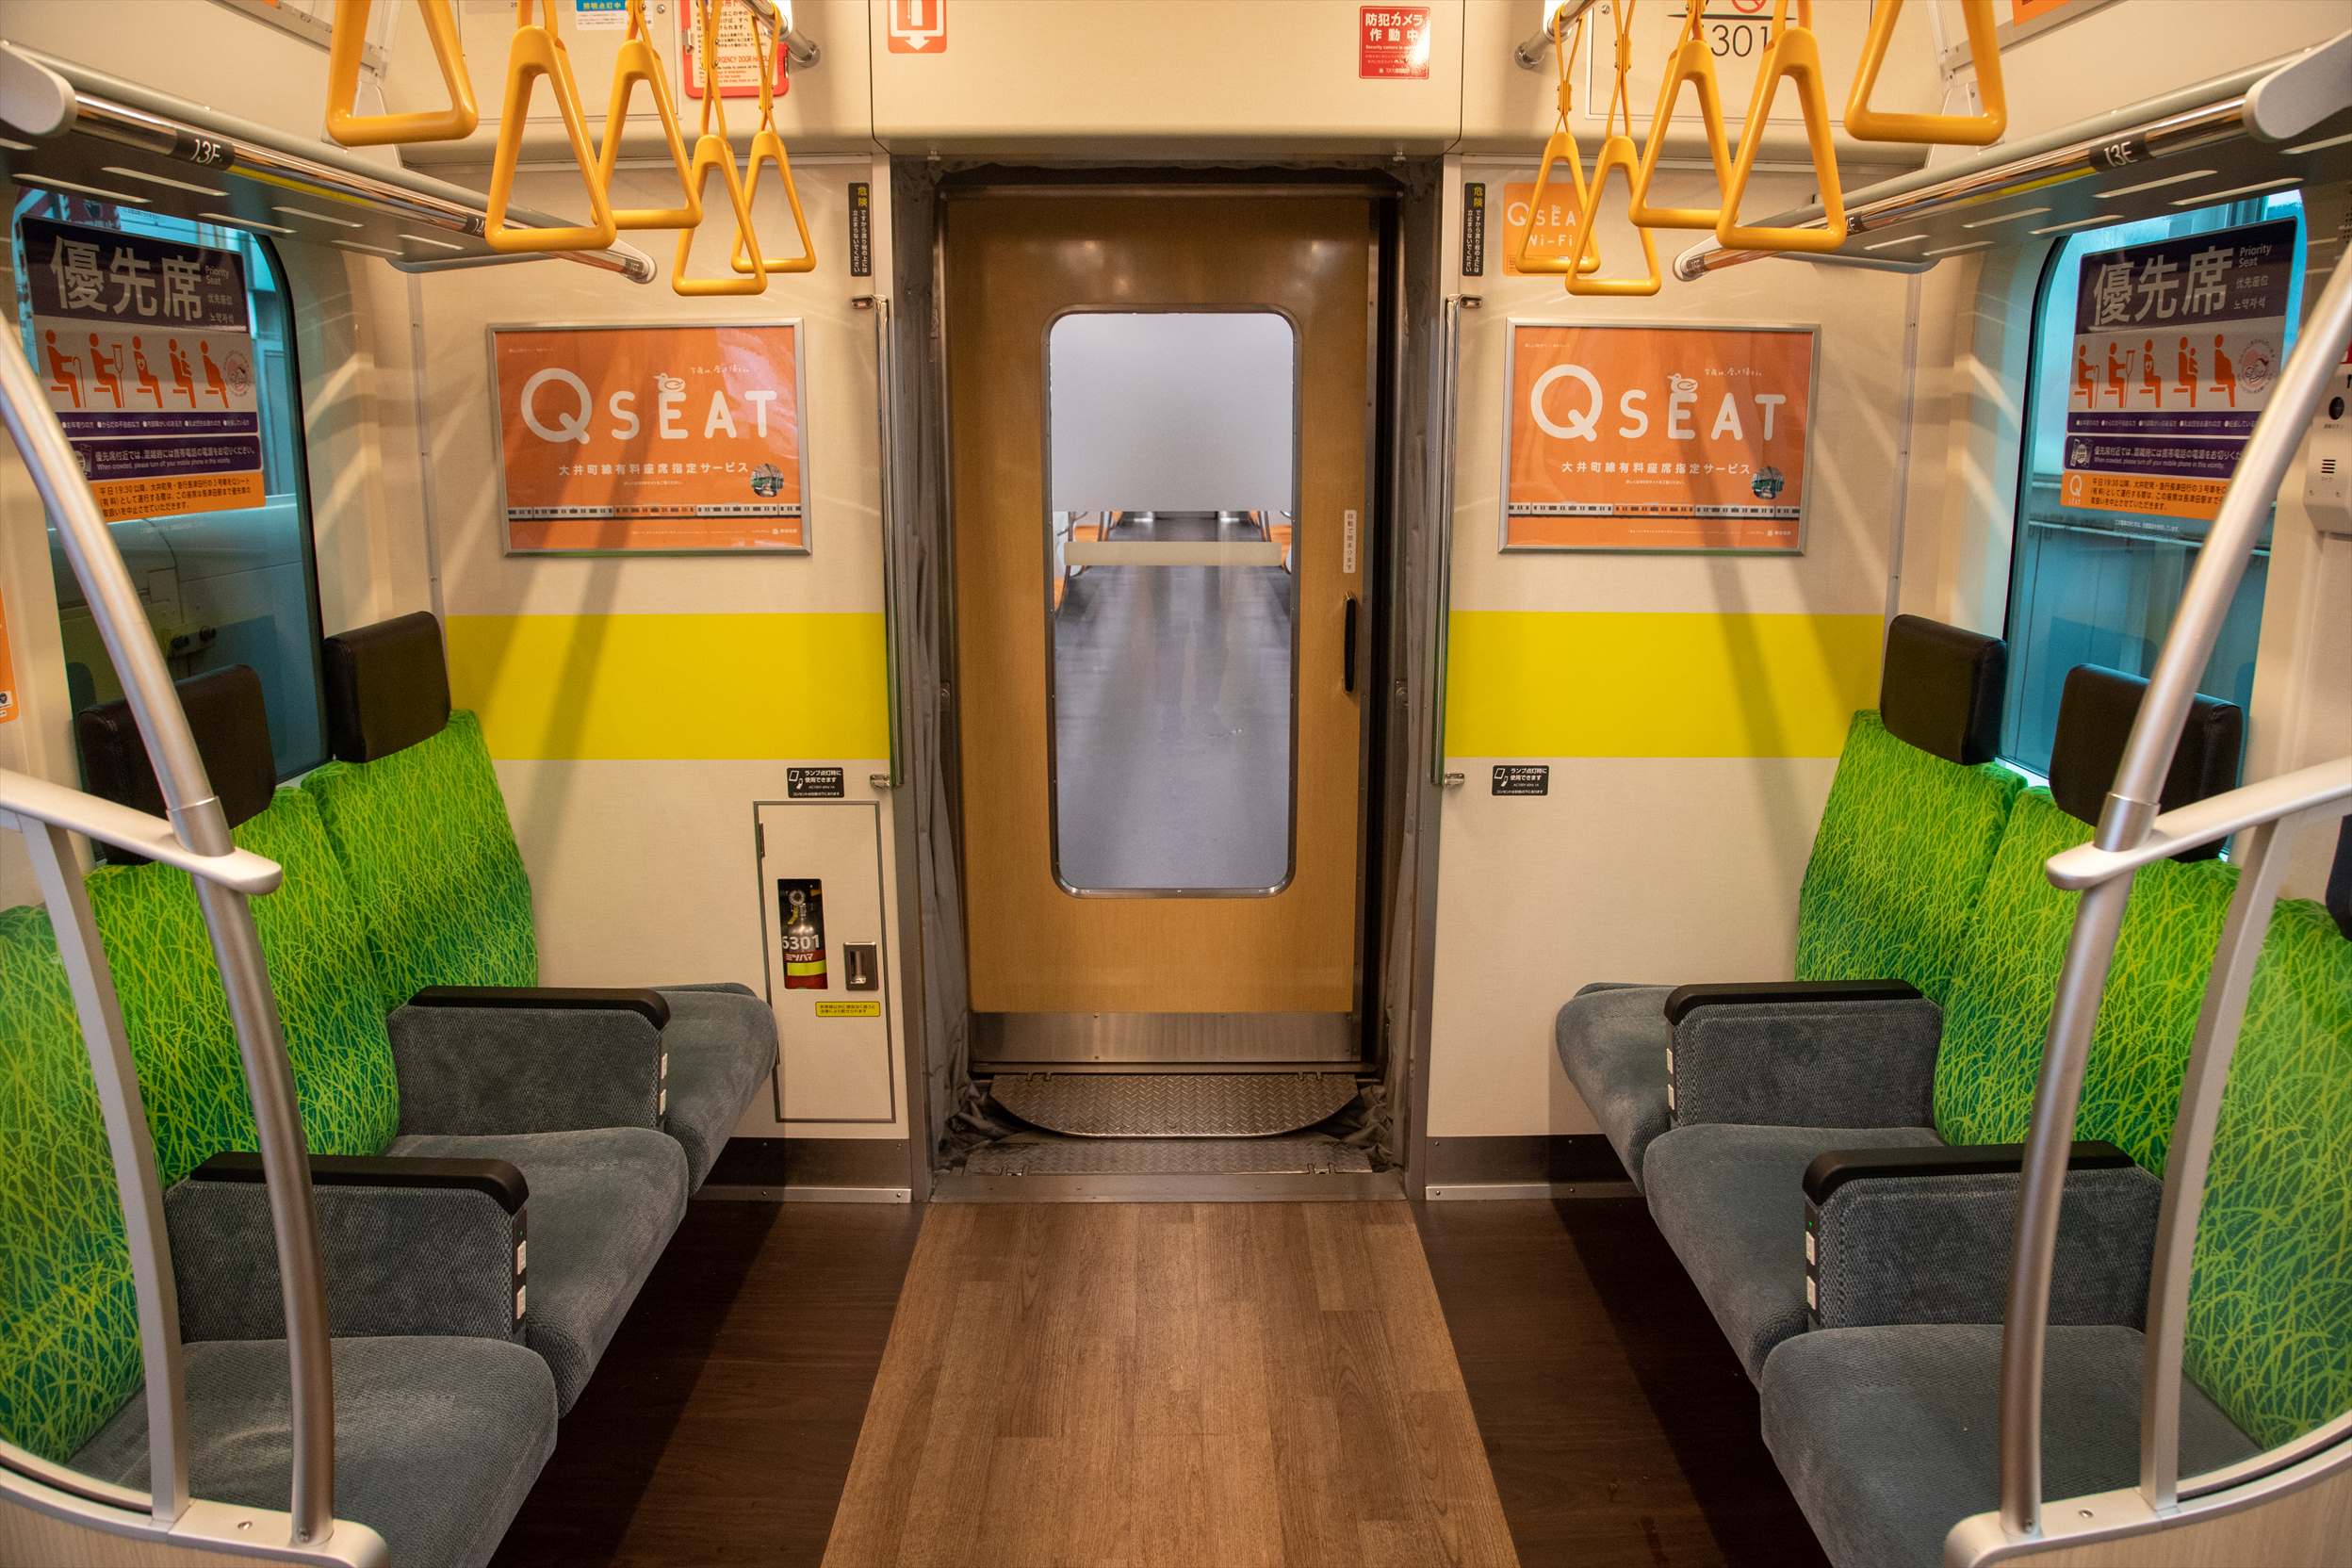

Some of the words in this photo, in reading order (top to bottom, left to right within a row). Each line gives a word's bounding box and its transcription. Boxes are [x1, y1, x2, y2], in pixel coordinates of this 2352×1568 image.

[1364, 11, 1424, 27] 防犯カメラ
[1369, 28, 1418, 42] 作動中
[1692, 24, 1768, 57] 301
[2103, 141, 2139, 168] 13E
[858, 187, 867, 207] 危険
[1473, 187, 1483, 207] 危険
[1508, 201, 1529, 226] Q
[1536, 209, 1582, 227] SEA
[2239, 243, 2272, 257] Priority
[2238, 257, 2258, 269] Seat
[50, 235, 204, 321] 優先席
[2093, 245, 2234, 326] 優先席
[520, 368, 593, 445] Q
[609, 390, 777, 440] SEAT
[1530, 364, 1603, 442] Q
[1619, 388, 1787, 441] SEAT
[559, 462, 749, 476] 大井町線有料座席指定サービス
[1560, 461, 1750, 475] 大井町線有料座席指定サービス
